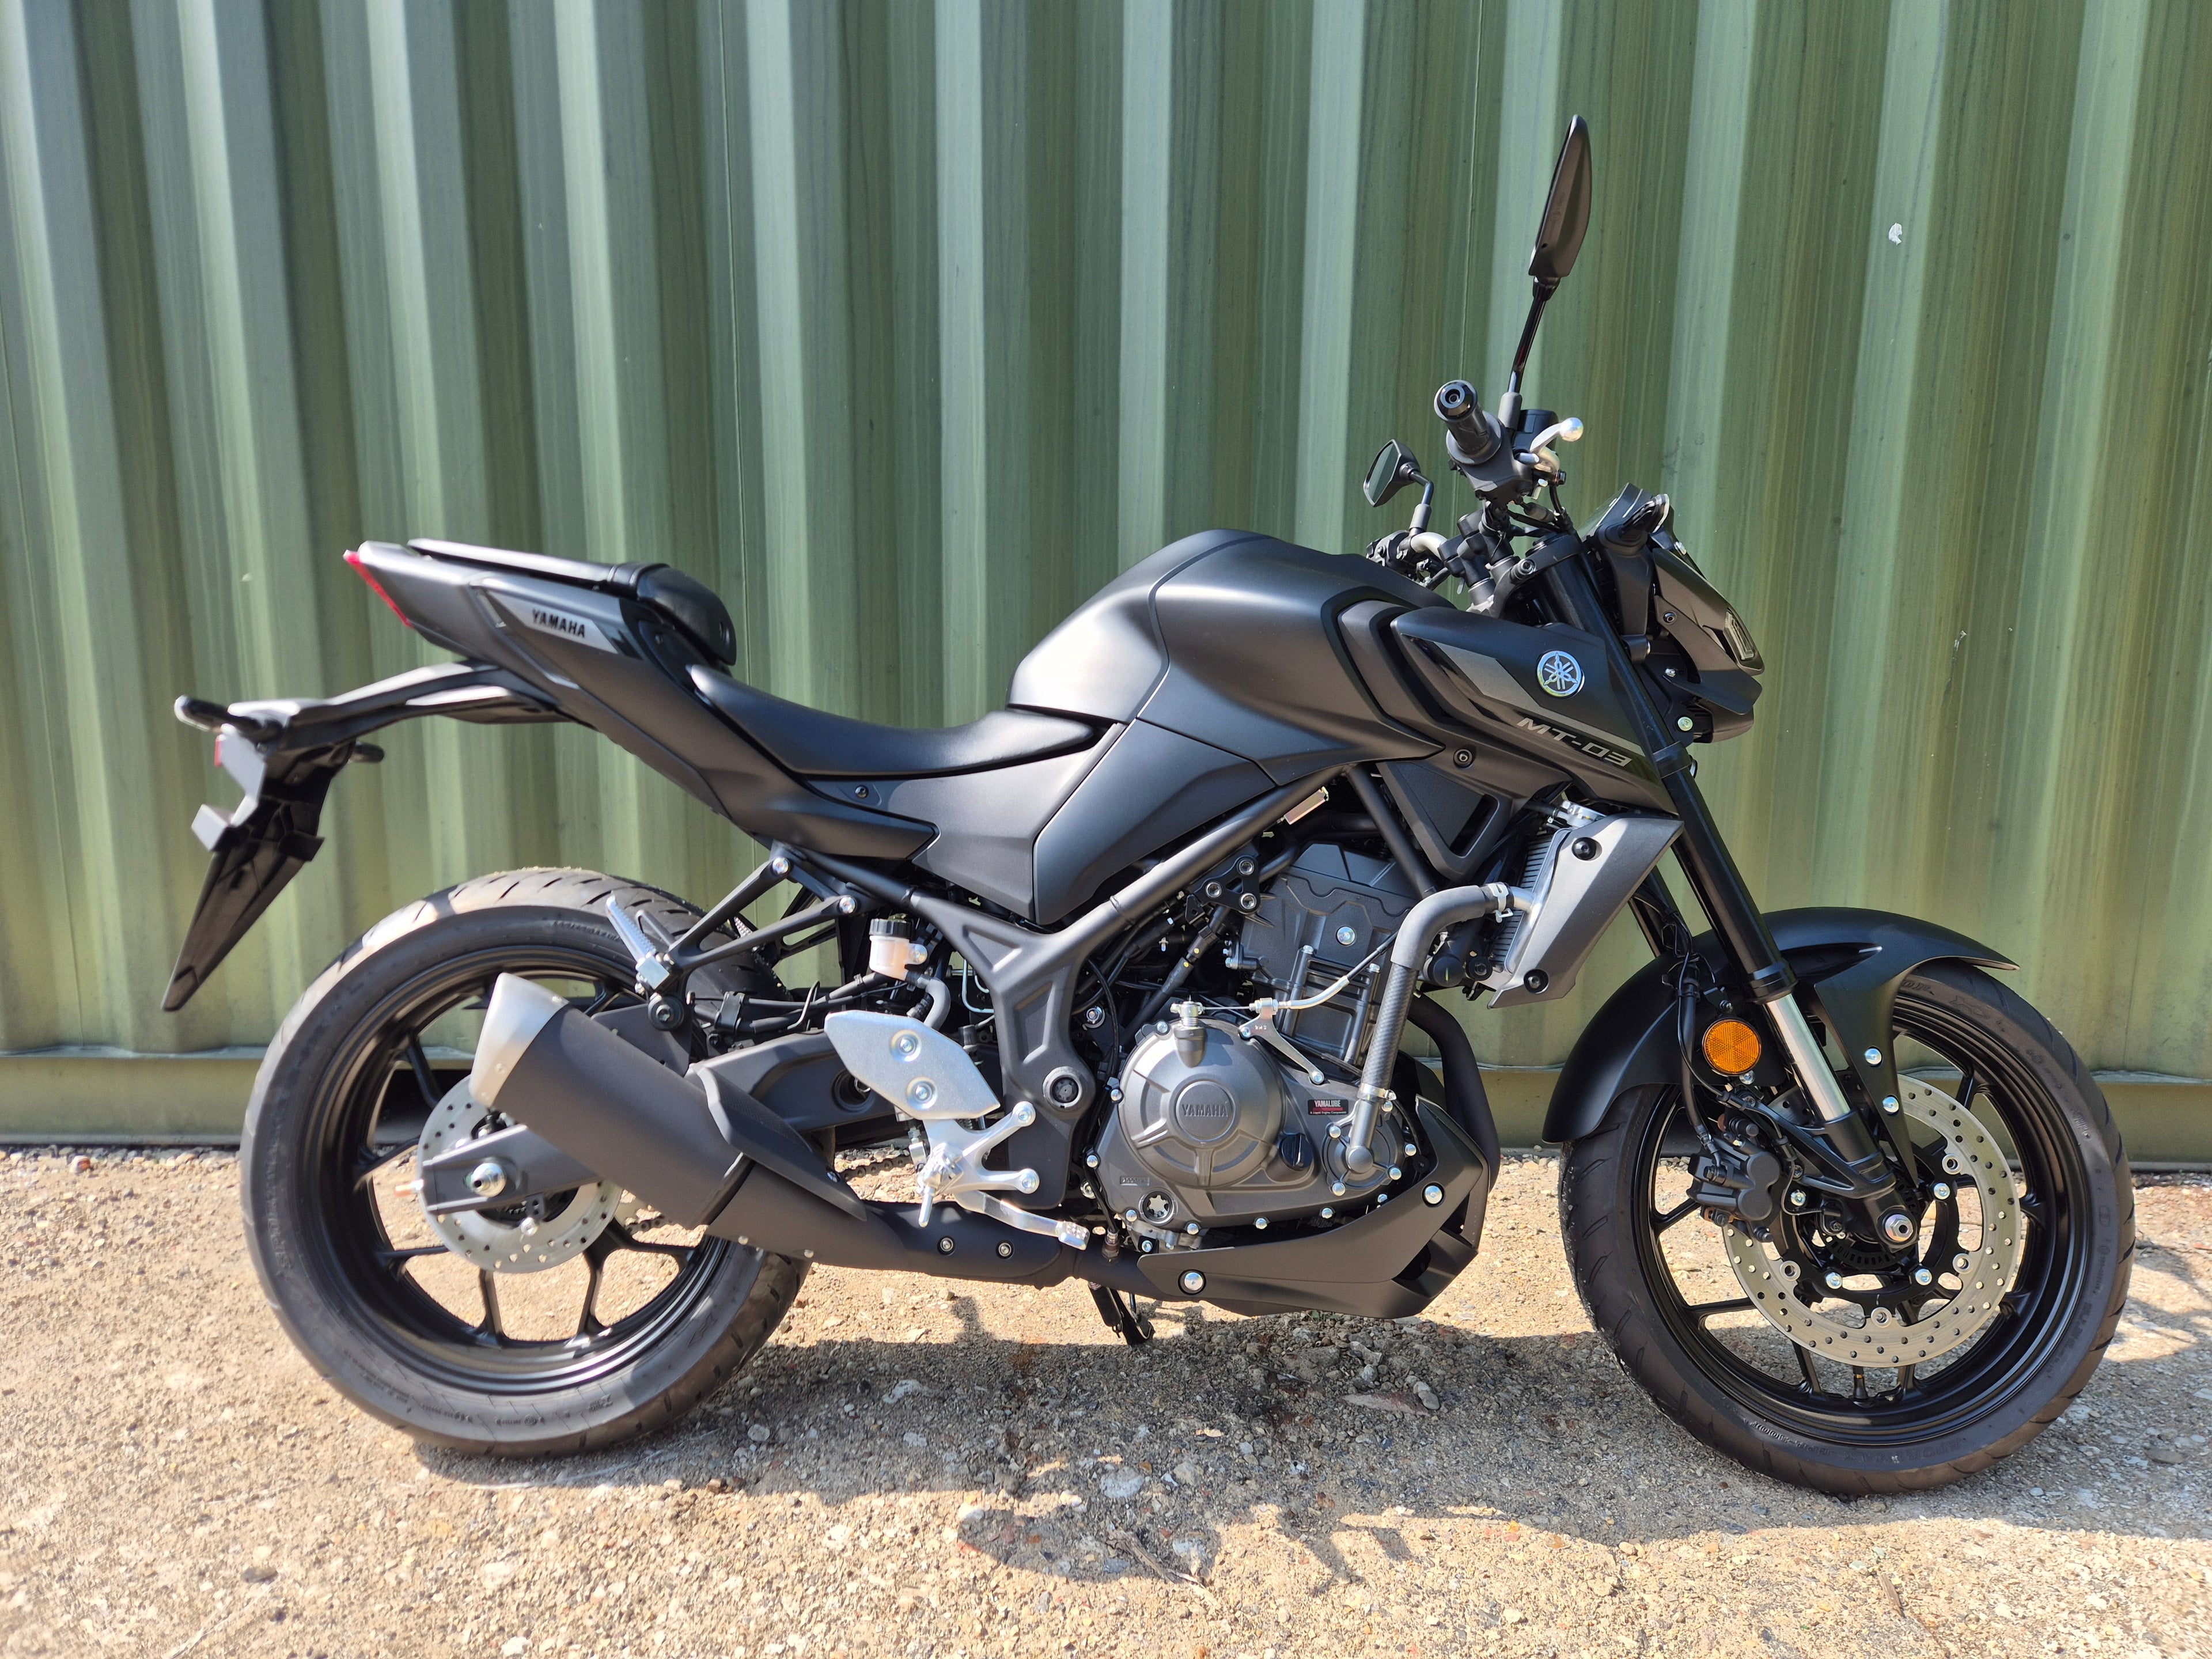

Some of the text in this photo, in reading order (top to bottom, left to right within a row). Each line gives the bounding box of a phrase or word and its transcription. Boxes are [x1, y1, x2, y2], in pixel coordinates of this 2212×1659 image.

[532, 608, 585, 638] YAMAHA
[1517, 717, 1633, 767] MT-03
[1181, 1104, 1229, 1117] YAMAHA
